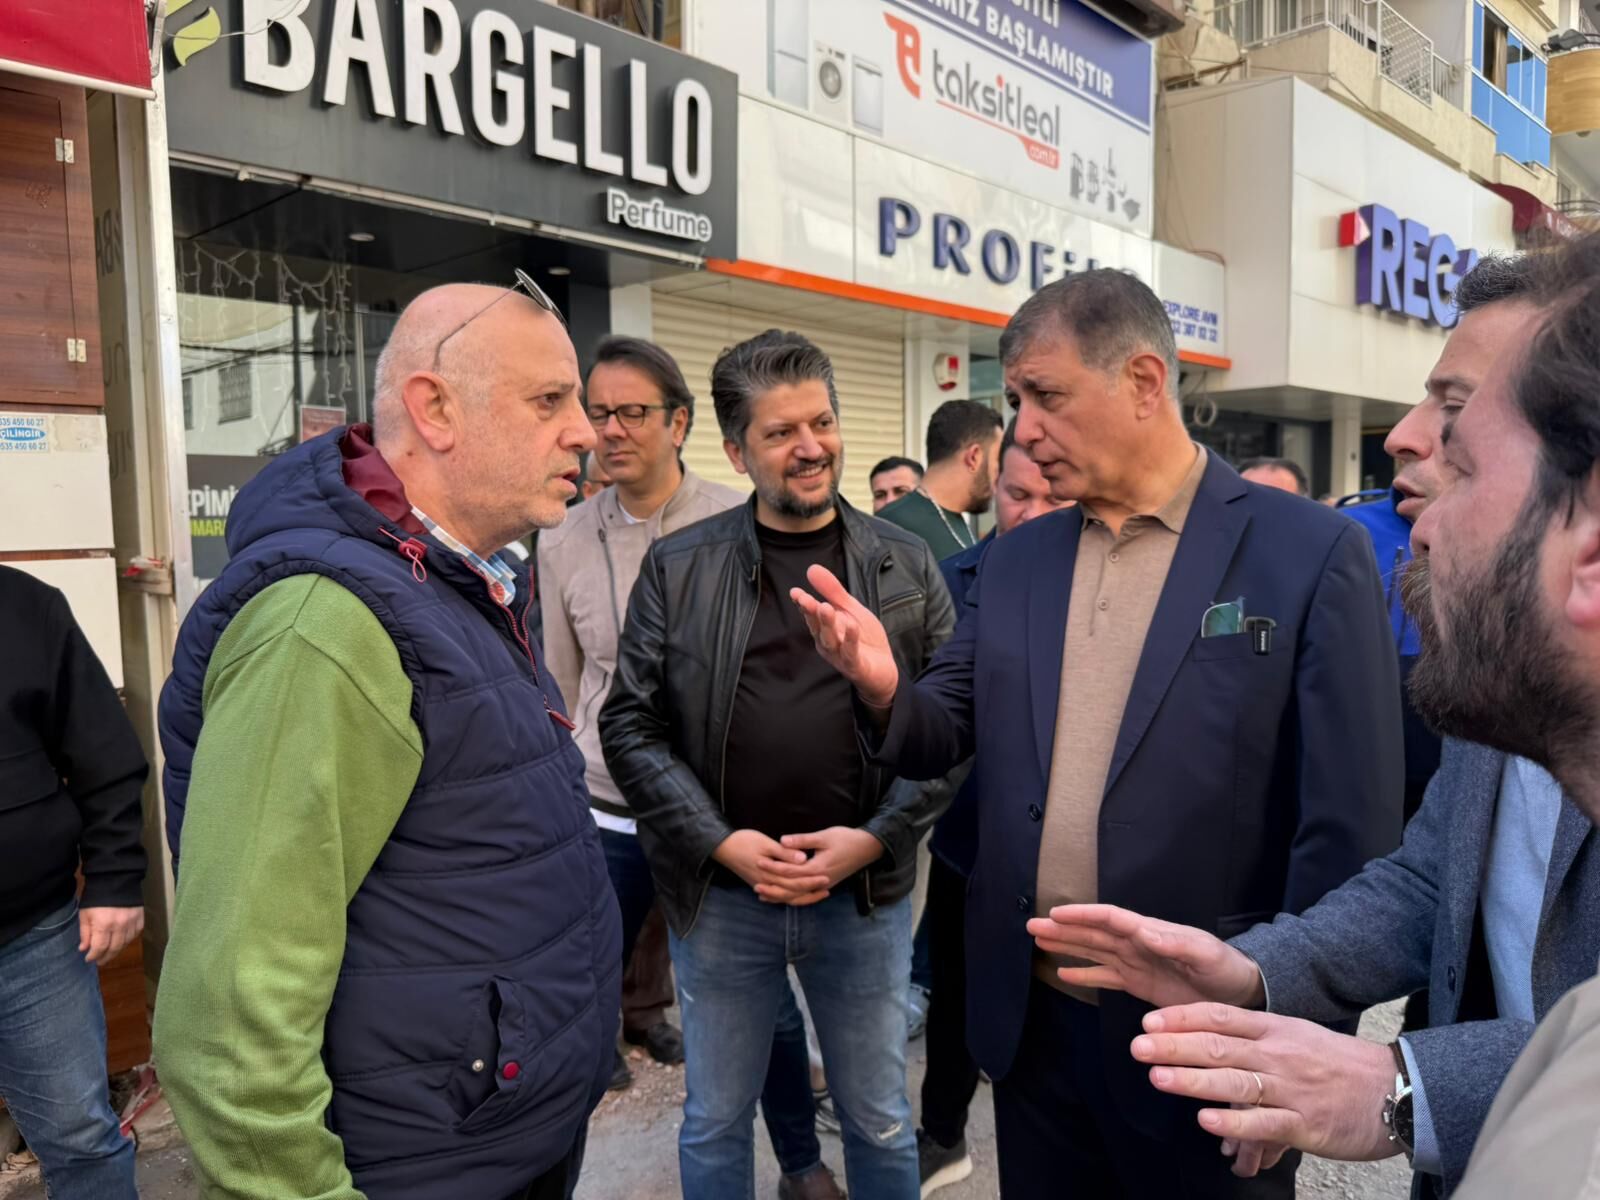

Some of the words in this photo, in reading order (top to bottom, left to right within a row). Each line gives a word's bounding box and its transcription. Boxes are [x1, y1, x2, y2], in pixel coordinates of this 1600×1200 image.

[243, 0, 712, 195] BARGELLO
[932, 47, 1060, 148] taksitleal
[986, 5, 1114, 99] BAŞLAMIŞTIR
[606, 187, 713, 243] Perfume
